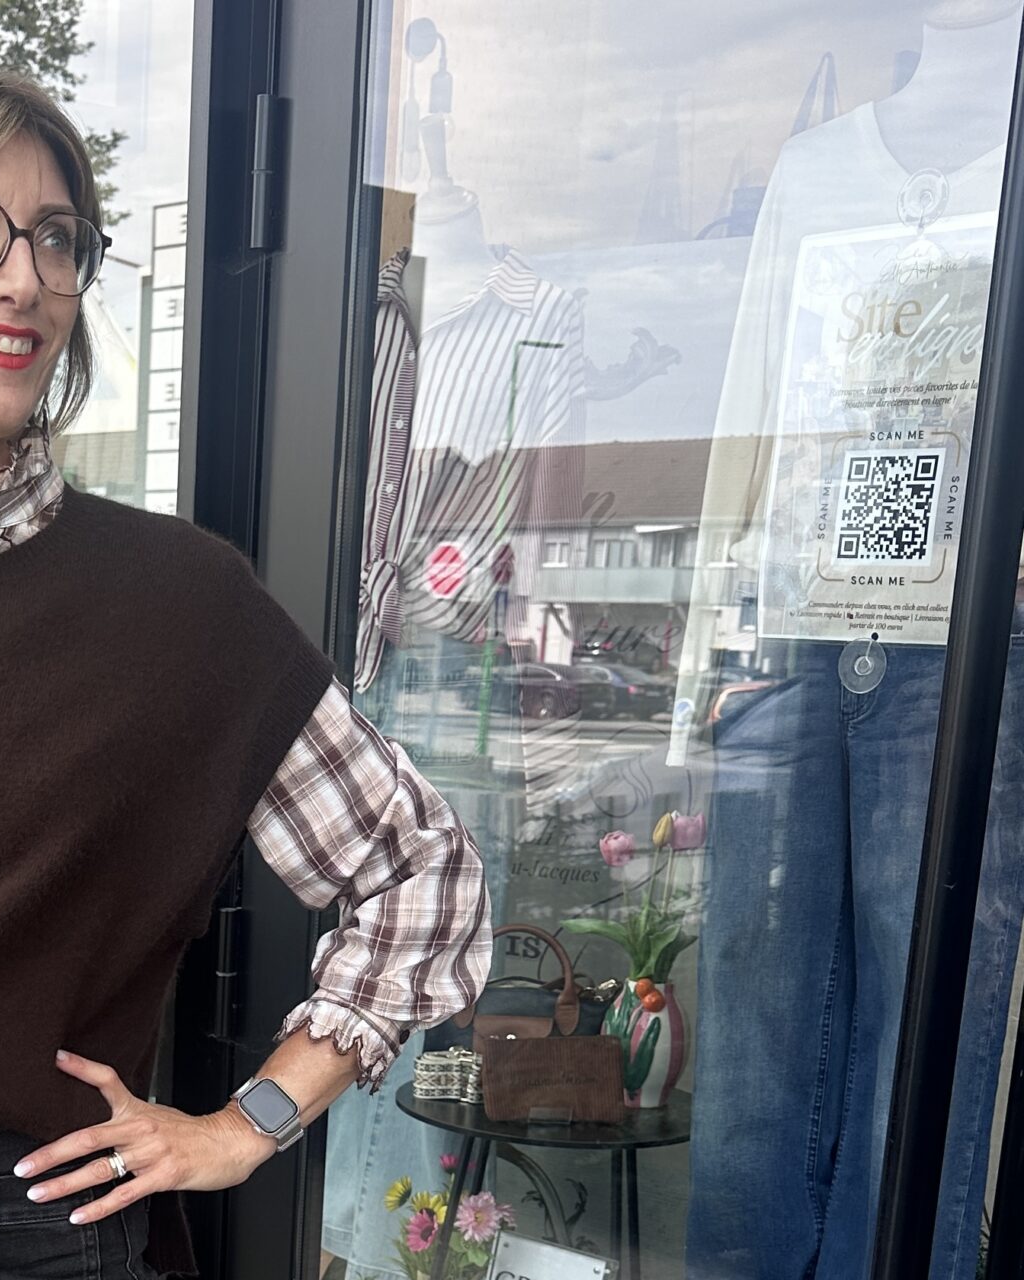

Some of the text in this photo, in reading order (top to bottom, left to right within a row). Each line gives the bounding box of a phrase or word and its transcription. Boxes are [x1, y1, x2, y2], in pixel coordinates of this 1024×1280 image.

[836, 287, 922, 343] Site
[924, 381, 958, 394] favorites
[960, 380, 970, 390] de
[921, 398, 930, 406] en
[869, 430, 925, 441] SCAN ME
[817, 477, 833, 540] SCAN ME
[943, 475, 960, 540] SCAN ME
[850, 575, 905, 586] SCAN ME
[902, 603, 915, 611] click
[916, 603, 929, 612] and
[929, 604, 949, 612] collect
[511, 860, 600, 884] u-Jacques
